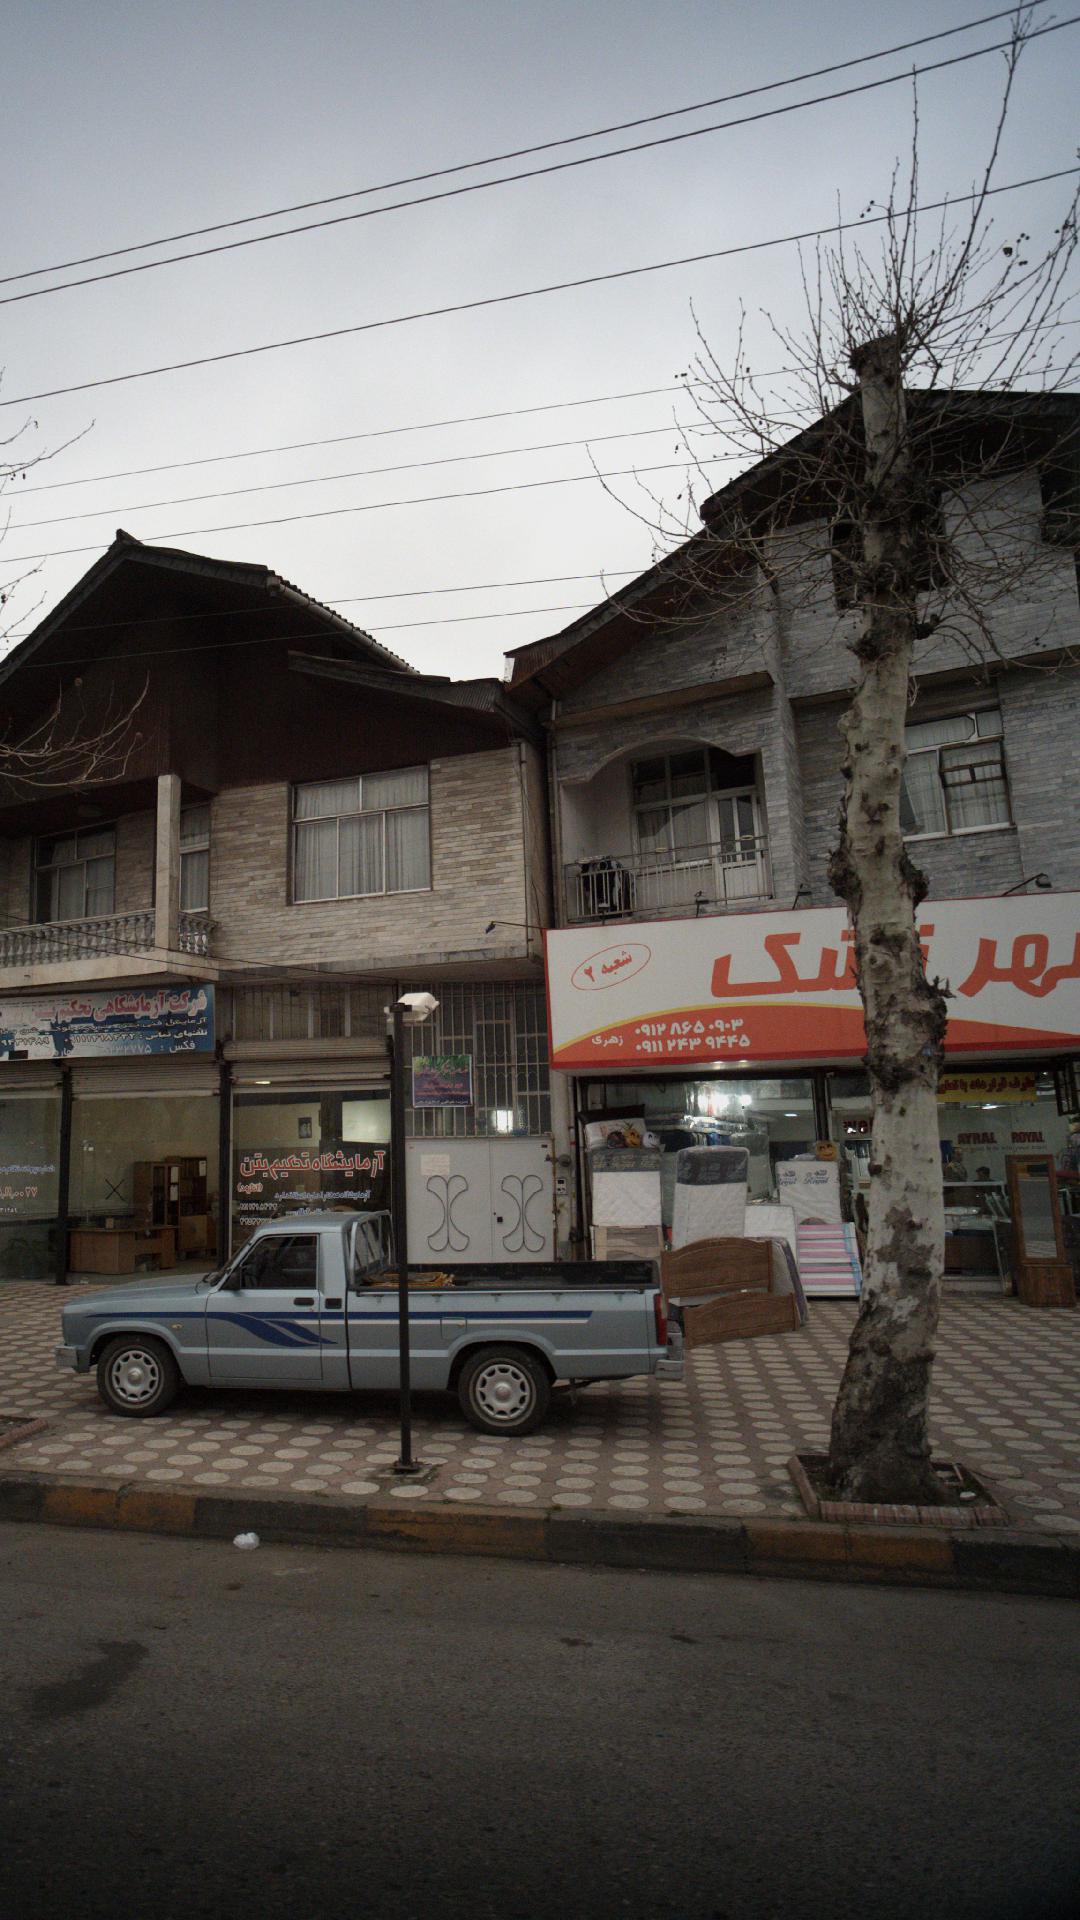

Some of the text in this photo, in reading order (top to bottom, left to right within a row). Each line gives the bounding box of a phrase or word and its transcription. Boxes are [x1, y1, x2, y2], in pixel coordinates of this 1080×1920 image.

[584, 951, 633, 983] شعبه ۲
[169, 990, 208, 1017] شرکت
[635, 1018, 744, 1036] ۰۹۱۲ ۸۶۵ ۰۹۰۳
[169, 1040, 196, 1054] فکس
[591, 1035, 624, 1048] زهری
[635, 1034, 750, 1053] ۰۹۱۱ ۲۴۳ ۹۴۴۵
[1011, 1131, 1045, 1144] ROYAL
[240, 1150, 386, 1180] آزمایشگاه تحکیم بتن
